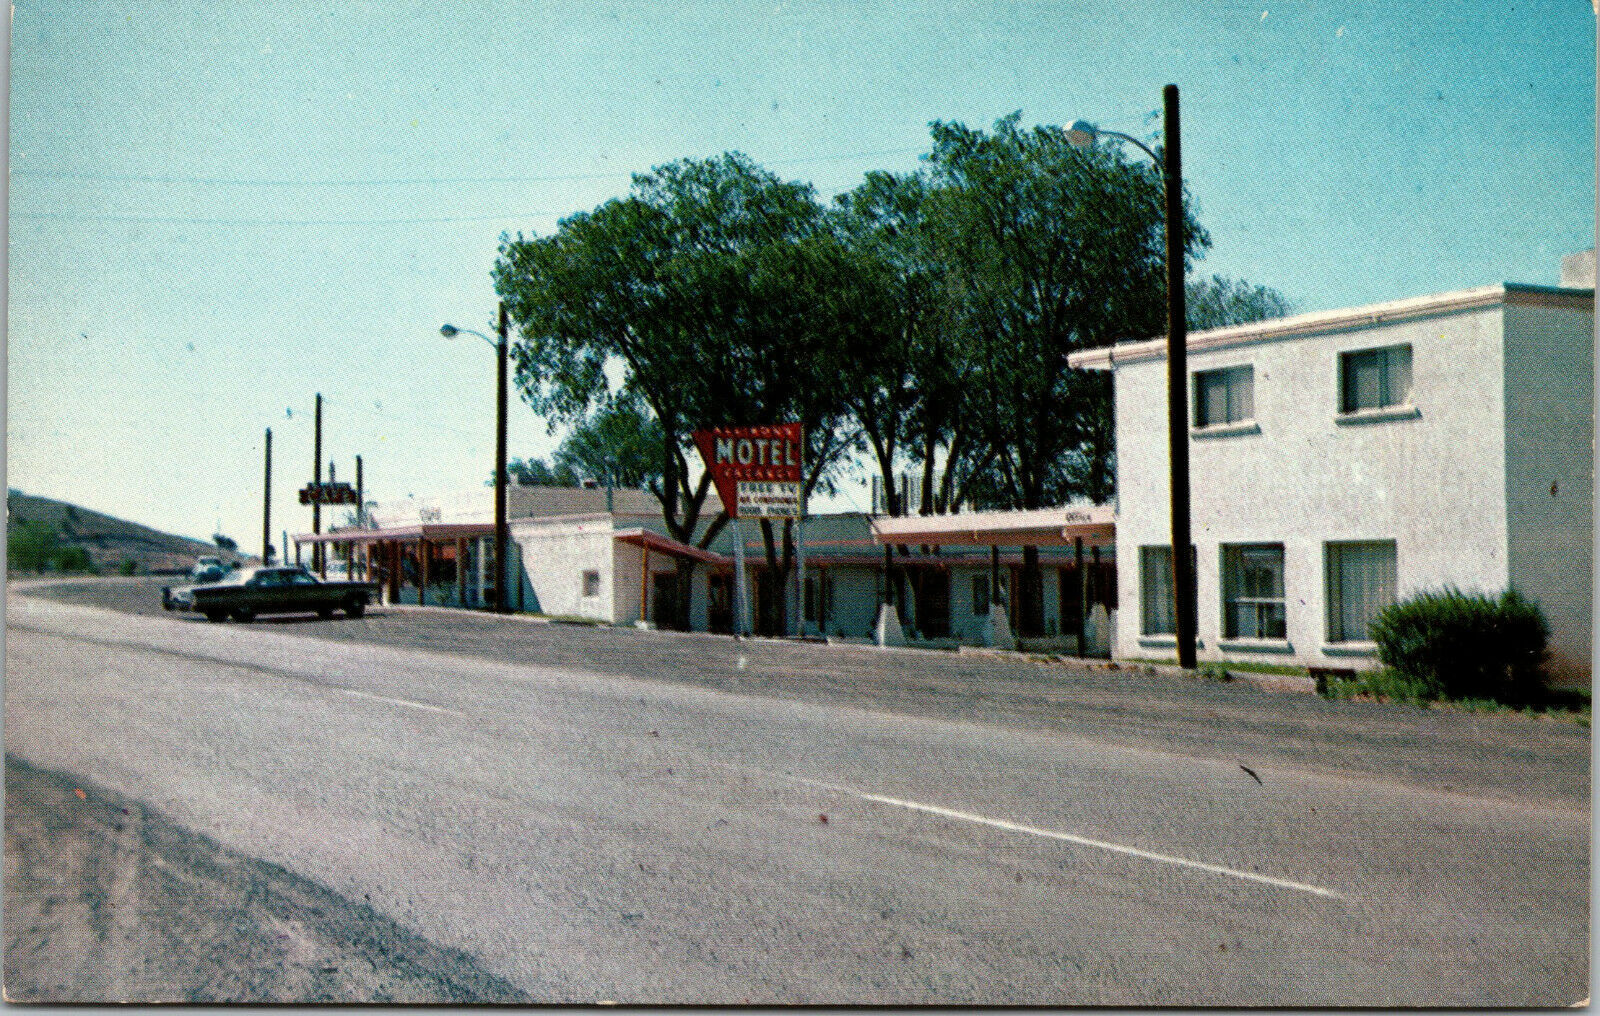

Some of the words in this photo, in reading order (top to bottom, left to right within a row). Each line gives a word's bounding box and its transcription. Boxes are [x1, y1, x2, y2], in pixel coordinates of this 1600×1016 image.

[716, 438, 796, 466] MOTEL
[740, 482, 772, 493] FREE
[780, 483, 796, 494] TV
